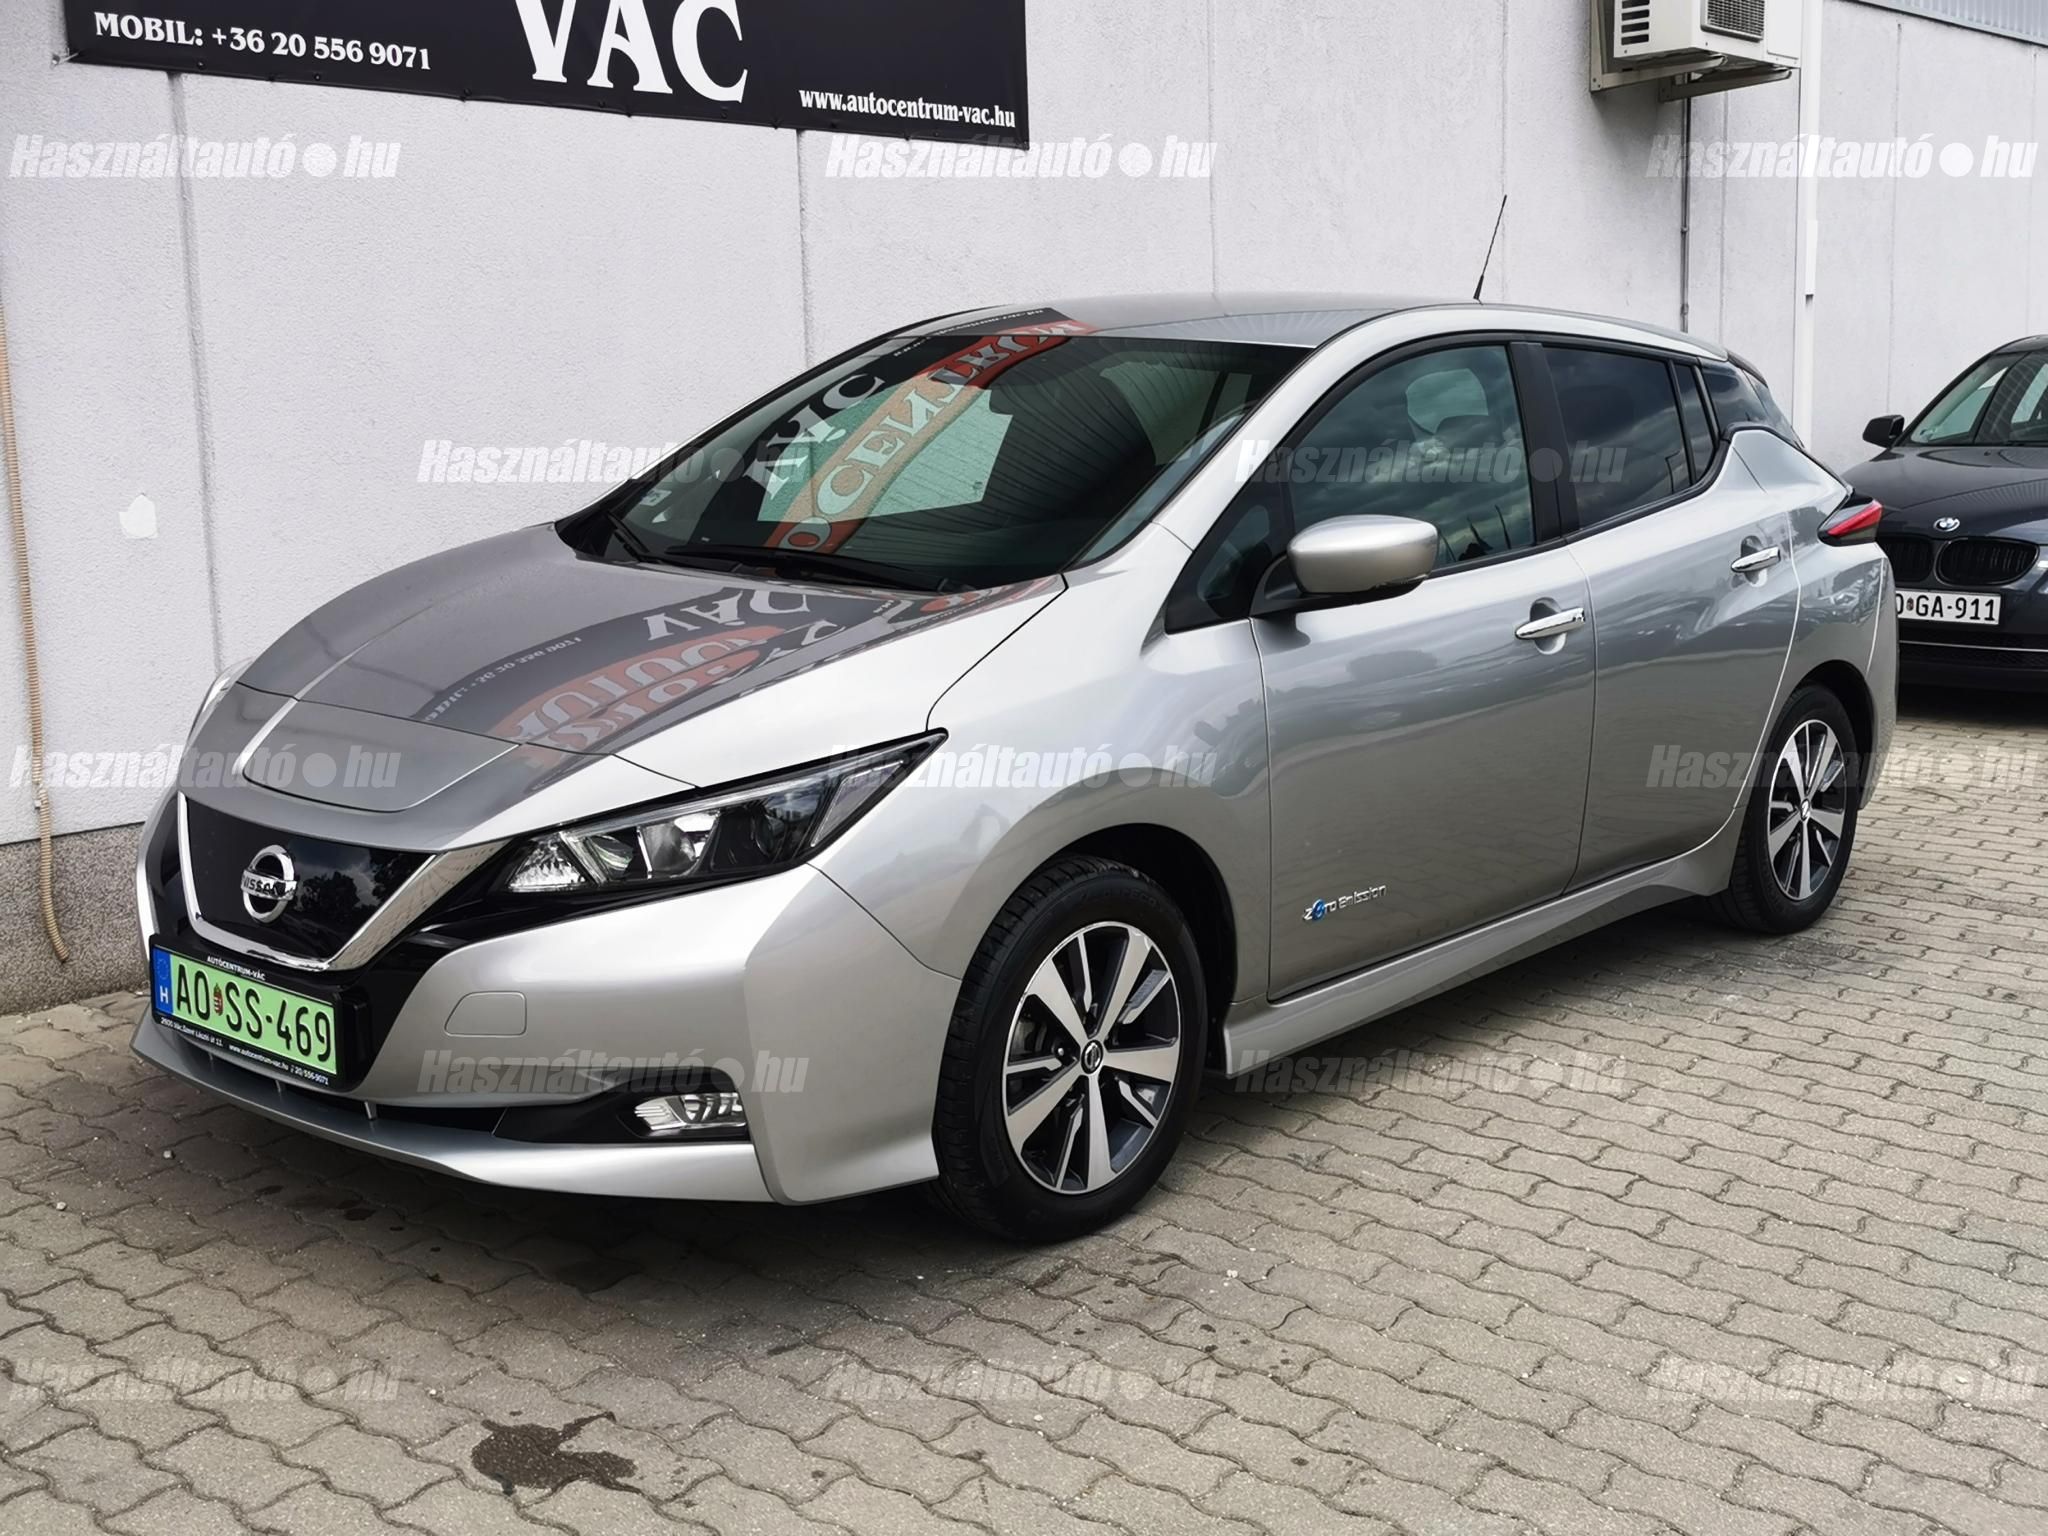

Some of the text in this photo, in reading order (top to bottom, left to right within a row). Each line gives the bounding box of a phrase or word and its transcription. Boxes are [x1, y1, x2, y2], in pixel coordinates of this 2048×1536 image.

[94, 11, 431, 70] MOBIL: +36 20 556 9071
[799, 89, 1016, 129] www.autocentrum-vac.hu
[1916, 594, 1996, 621] GA-911
[159, 985, 170, 1004] H
[176, 963, 332, 1063] AO SS-469
